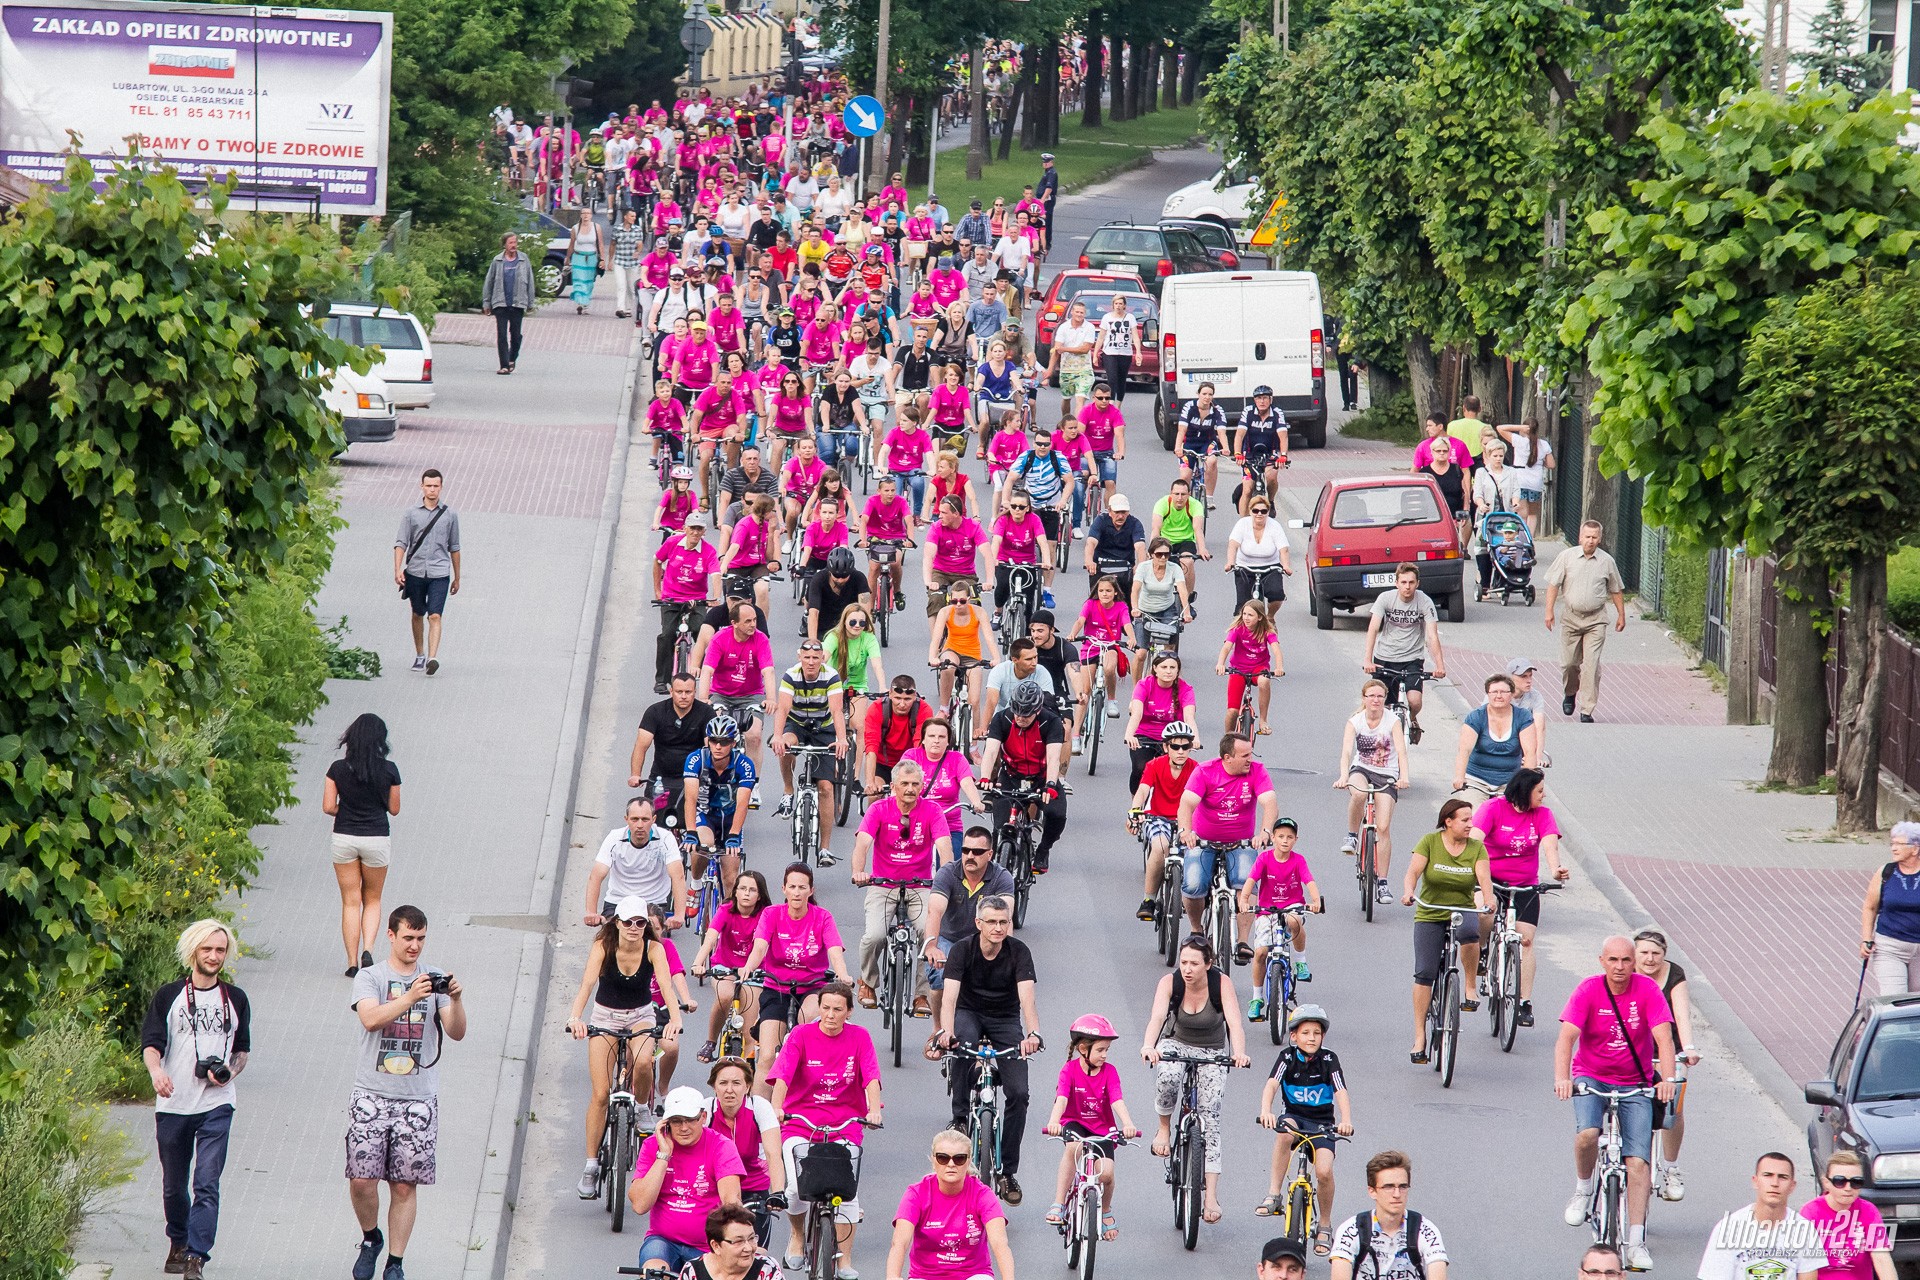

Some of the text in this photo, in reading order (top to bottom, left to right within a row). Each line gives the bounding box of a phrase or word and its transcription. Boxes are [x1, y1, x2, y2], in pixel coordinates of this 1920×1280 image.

[32, 17, 353, 48] ZAKŁAD OPIEKI ZDROWOTNEJ
[173, 85, 189, 93] UL.
[192, 86, 215, 94] 3-GO
[218, 87, 244, 96] MAJA
[262, 89, 269, 97] A
[136, 93, 245, 105] OSIEDLE GARBARSKIE
[130, 105, 251, 121] TEL. 81 85 43 711
[320, 103, 353, 119] NFZ
[197, 138, 209, 151] O
[216, 140, 277, 154] TWOJE
[283, 142, 365, 158] ZDROWIE
[328, 182, 367, 194] DOPPLER
[1193, 373, 1205, 382] LU
[1367, 574, 1385, 585] LUB
[380, 1039, 423, 1052] ME OFF
[1293, 1087, 1324, 1105] sky
